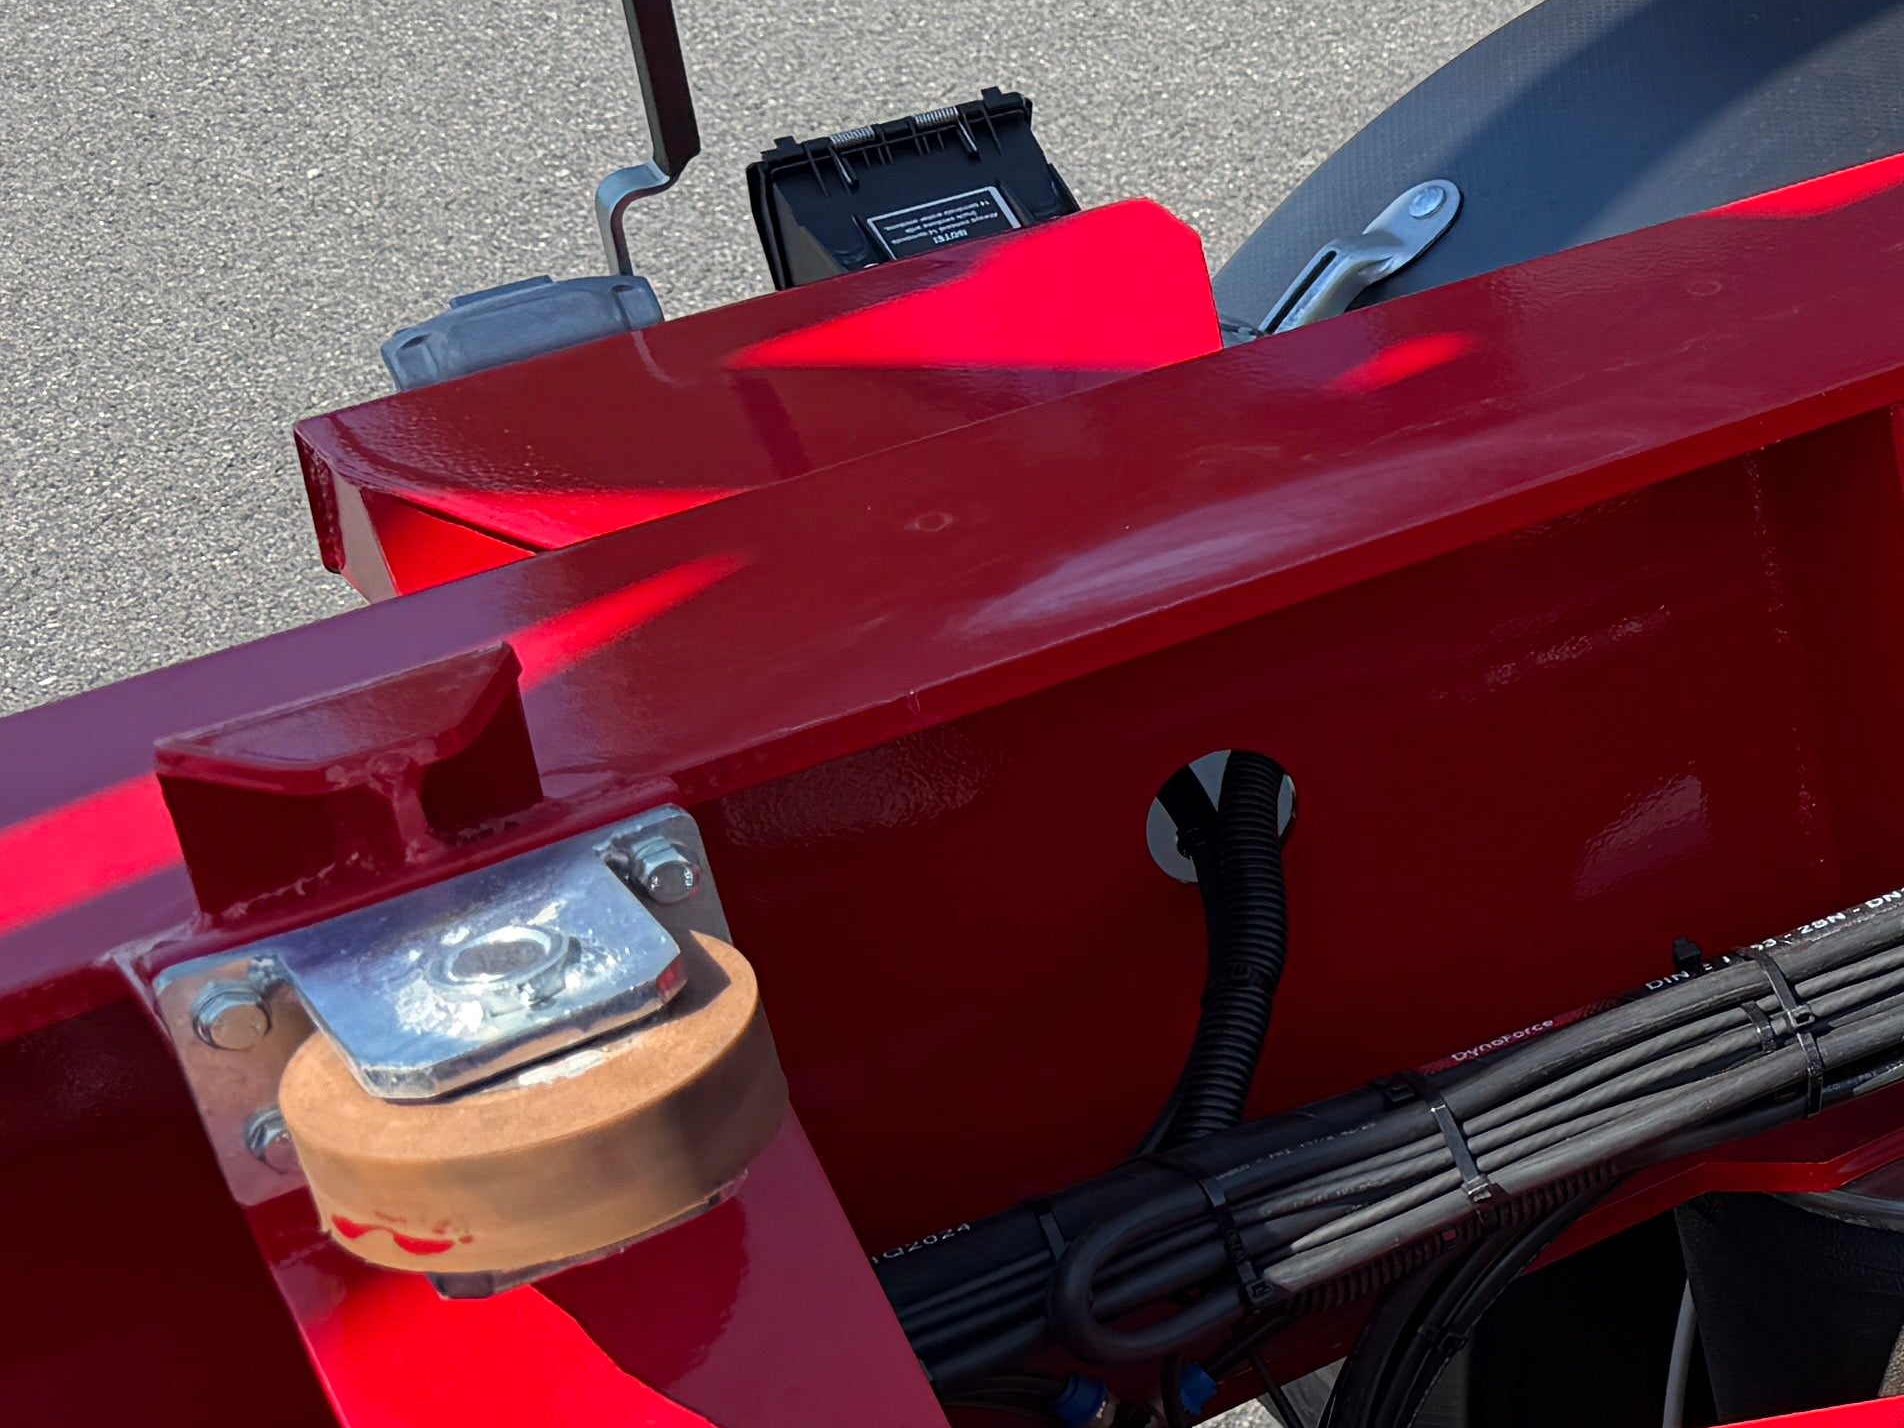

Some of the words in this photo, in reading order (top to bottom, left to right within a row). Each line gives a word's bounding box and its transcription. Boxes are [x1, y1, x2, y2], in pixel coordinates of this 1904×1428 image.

[1451, 1019, 1554, 1064] DynoForce
[1645, 970, 1690, 991] DIN
[1798, 912, 1847, 935] 2SN
